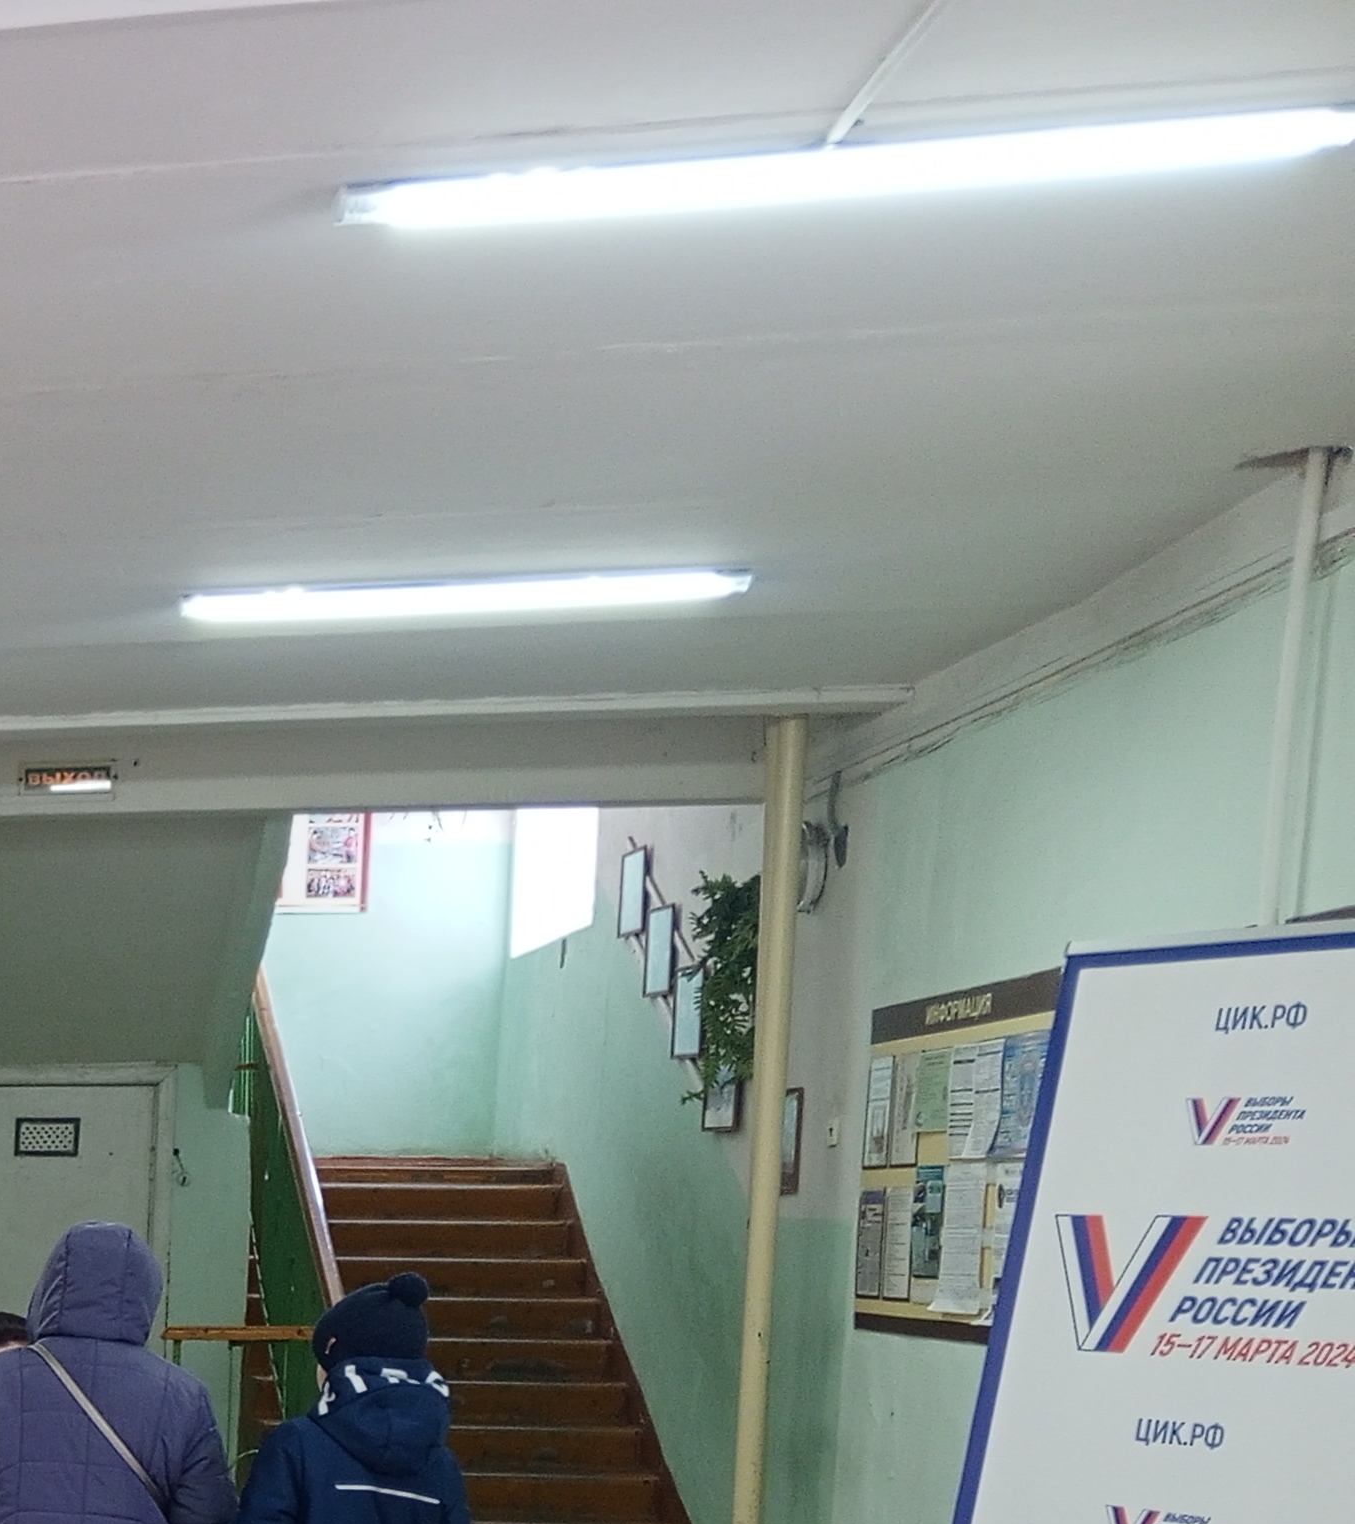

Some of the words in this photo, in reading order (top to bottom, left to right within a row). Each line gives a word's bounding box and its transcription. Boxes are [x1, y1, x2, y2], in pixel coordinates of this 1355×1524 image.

[926, 991, 992, 1026] ИНФОРМАЦИЯ
[1215, 1001, 1308, 1035] ЦИК.РФ
[1236, 1109, 1307, 1122] ПРЕЗИДЕНТА
[1244, 1096, 1294, 1108] ВЫБОРЫ
[1227, 1123, 1273, 1135] РОССИИ
[1167, 1296, 1308, 1329] РОССИИ
[1212, 1336, 1299, 1366] МАРТА
[1296, 1341, 1355, 1369] 2024
[1134, 1417, 1226, 1450] ЦИК.РФ
